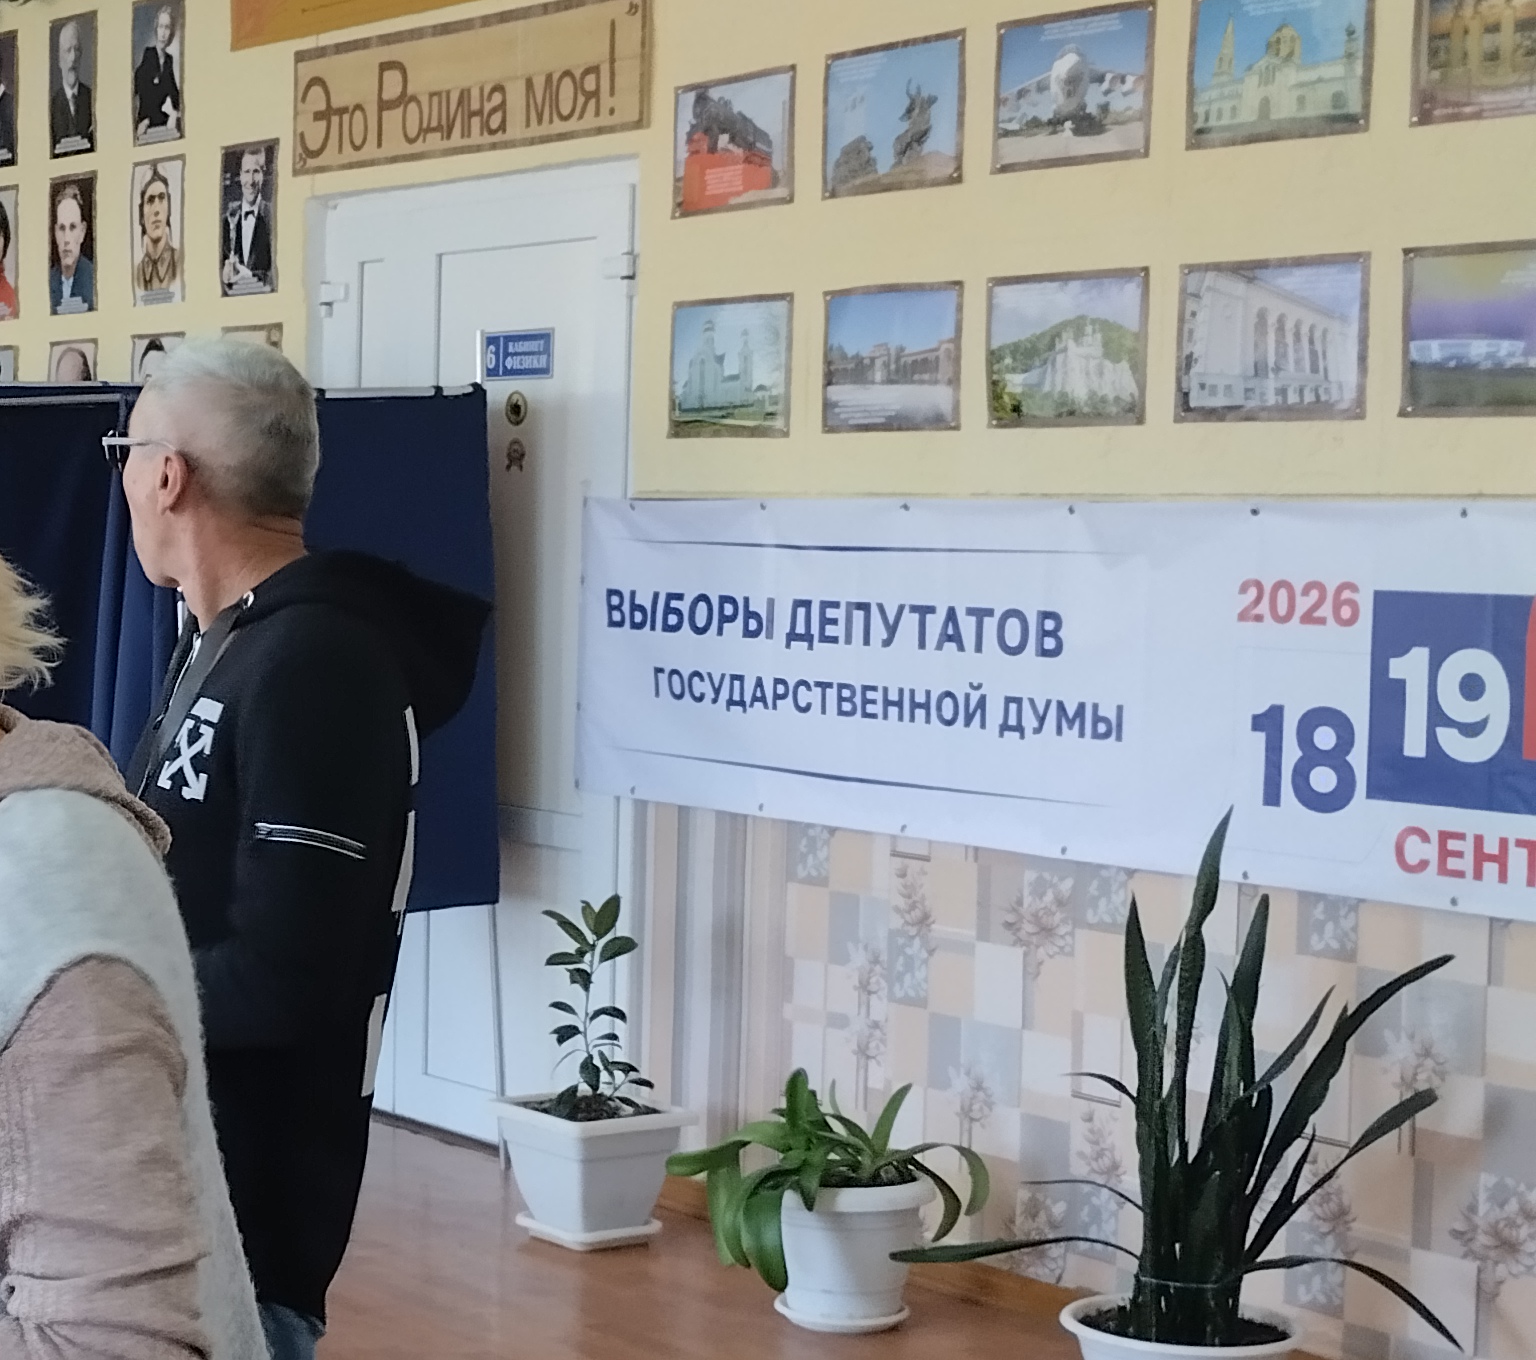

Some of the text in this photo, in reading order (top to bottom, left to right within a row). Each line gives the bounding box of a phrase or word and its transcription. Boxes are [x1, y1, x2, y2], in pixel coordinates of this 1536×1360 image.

[297, 76, 369, 159] Это
[375, 59, 507, 149] Родина
[486, 344, 496, 369] 6
[504, 354, 548, 370] ФИЗИКИ
[604, 587, 1065, 659] ВЫБОРЫ ДЕПУТАТОВ
[1236, 578, 1361, 628] 2026
[653, 665, 1124, 742] ГОСУДАРСТВЕННОЙ ДУМЫ
[1250, 646, 1511, 814] 18 19
